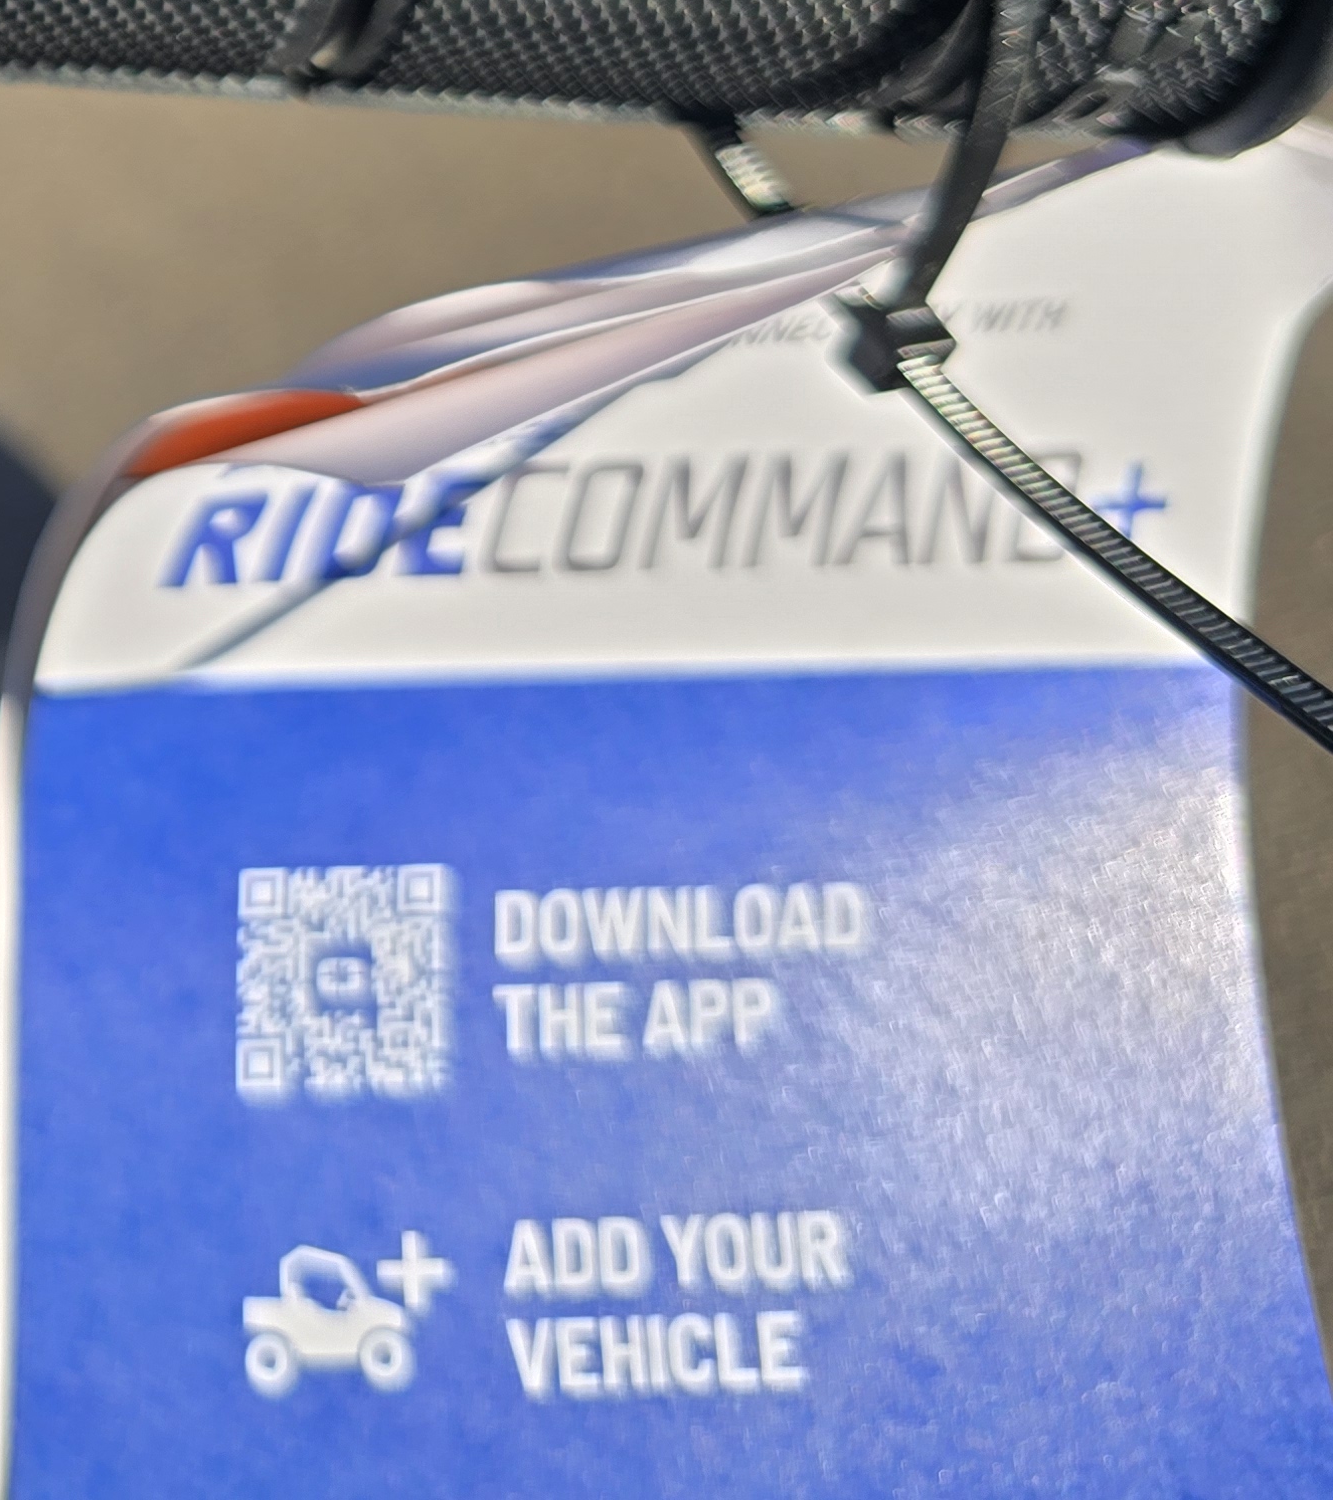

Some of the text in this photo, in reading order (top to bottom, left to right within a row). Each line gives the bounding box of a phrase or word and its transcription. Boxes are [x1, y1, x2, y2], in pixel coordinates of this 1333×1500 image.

[973, 297, 1069, 334] WITH
[493, 881, 863, 965] DOWNLOAD
[491, 977, 774, 1062] THE APP
[503, 1209, 851, 1298] ADD YOUR
[505, 1309, 807, 1398] VEHICLE
